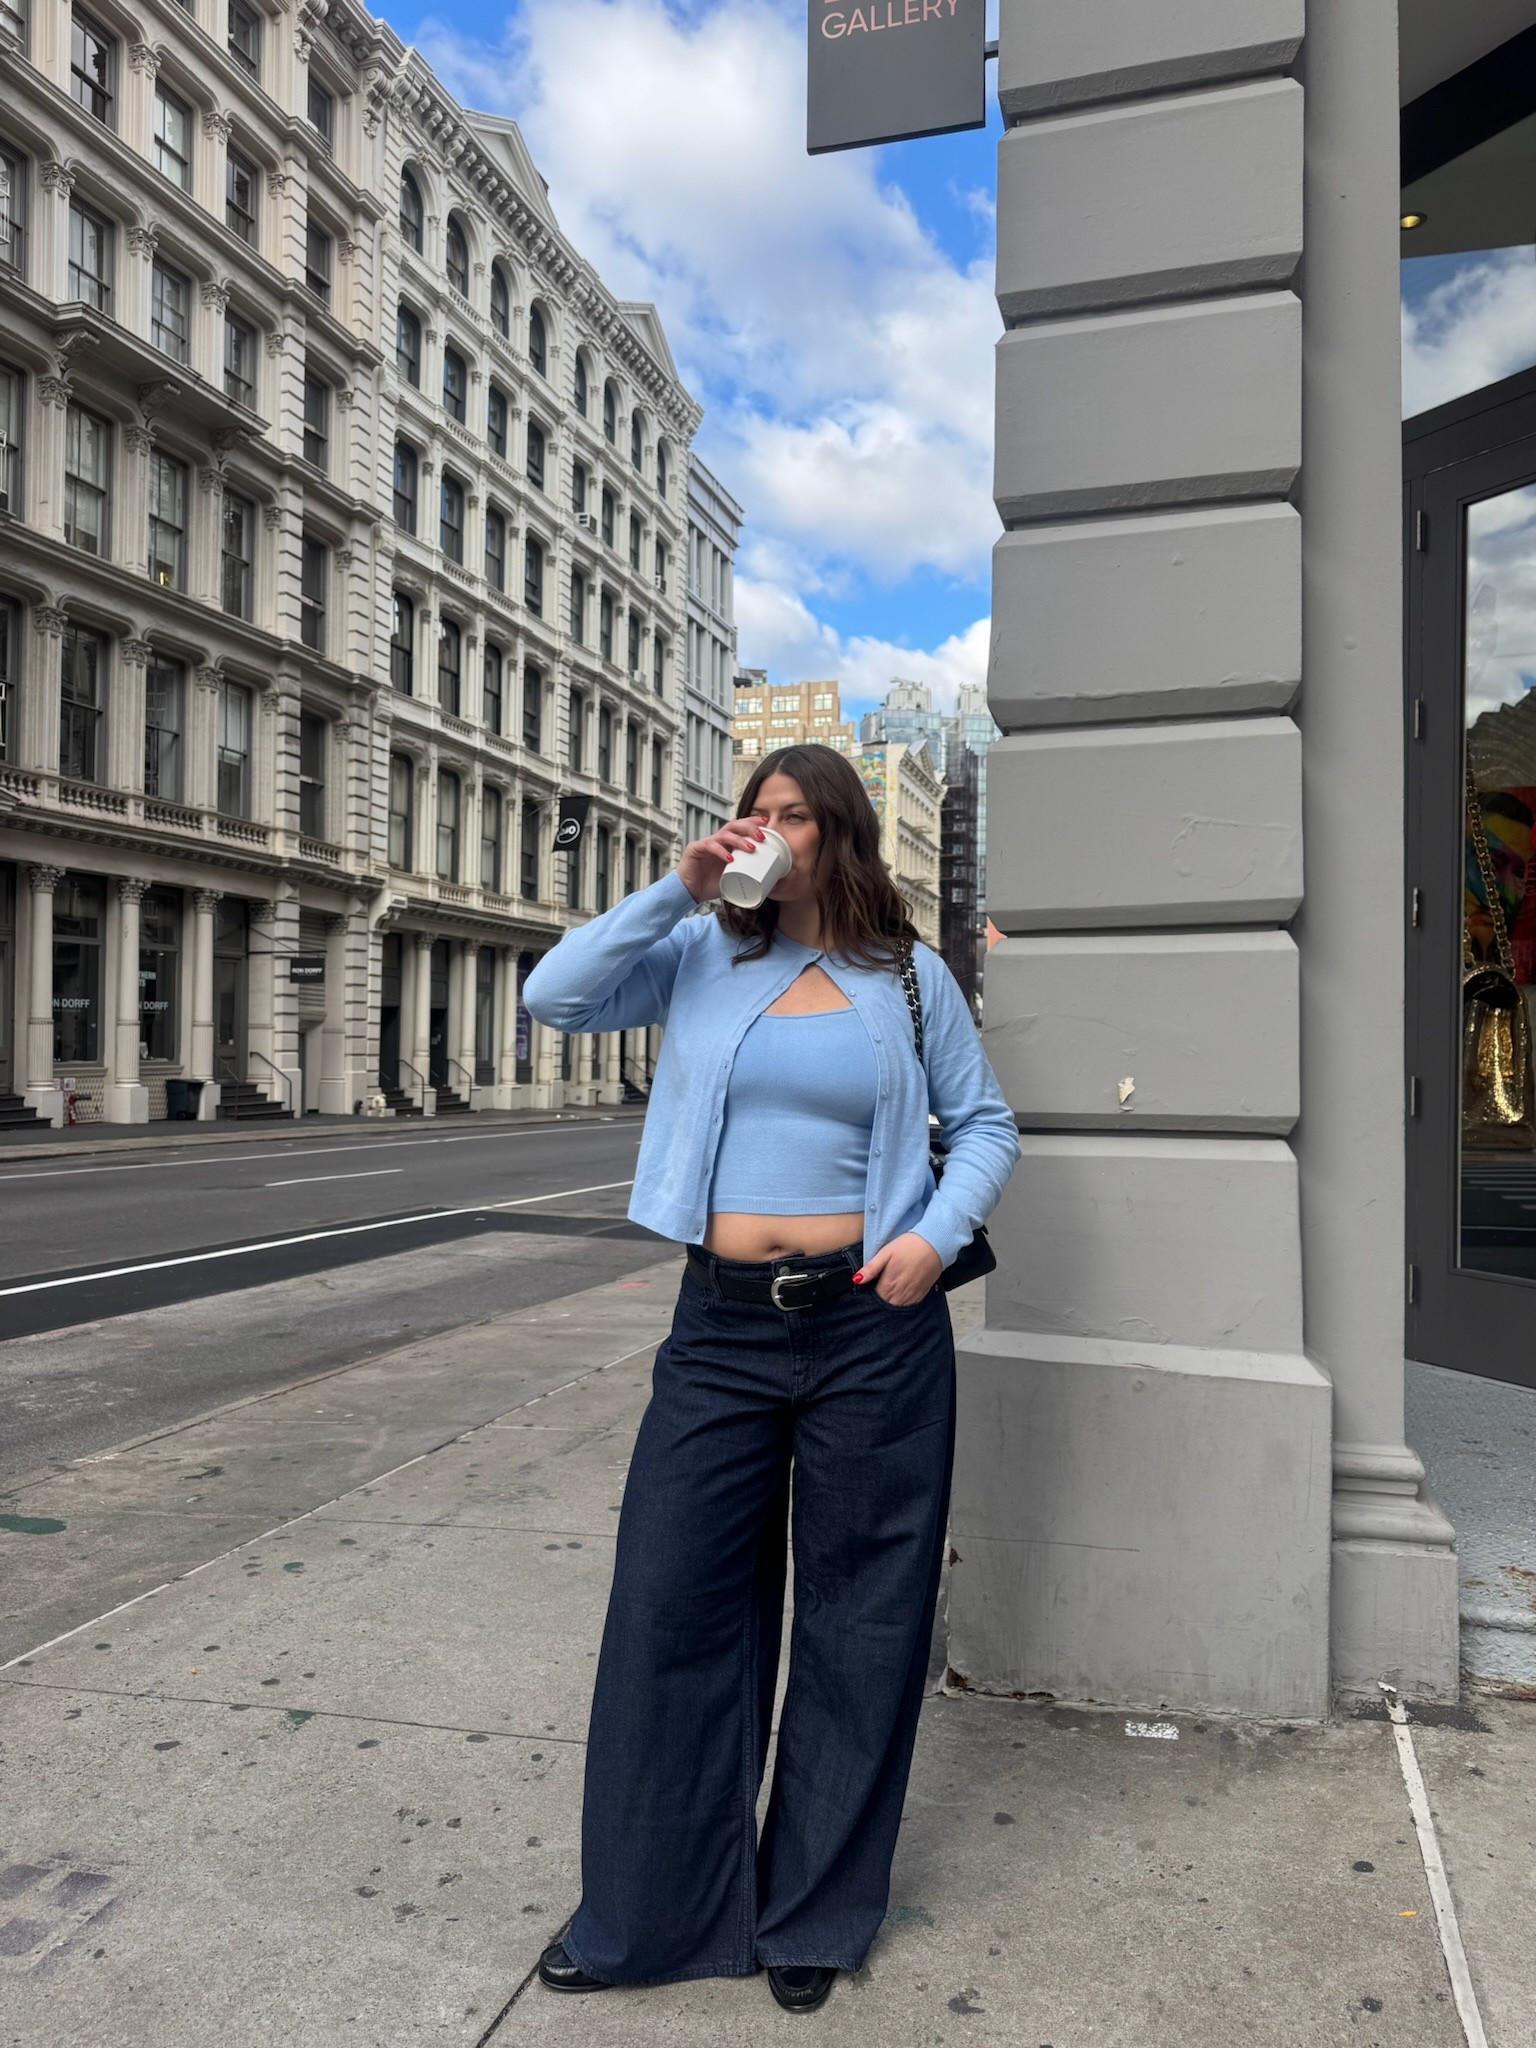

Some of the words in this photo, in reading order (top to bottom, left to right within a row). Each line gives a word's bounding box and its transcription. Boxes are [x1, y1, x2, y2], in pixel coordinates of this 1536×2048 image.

[821, 0, 957, 39] GALLERY
[61, 998, 91, 1009] DORFF
[143, 1001, 169, 1011] DORFF
